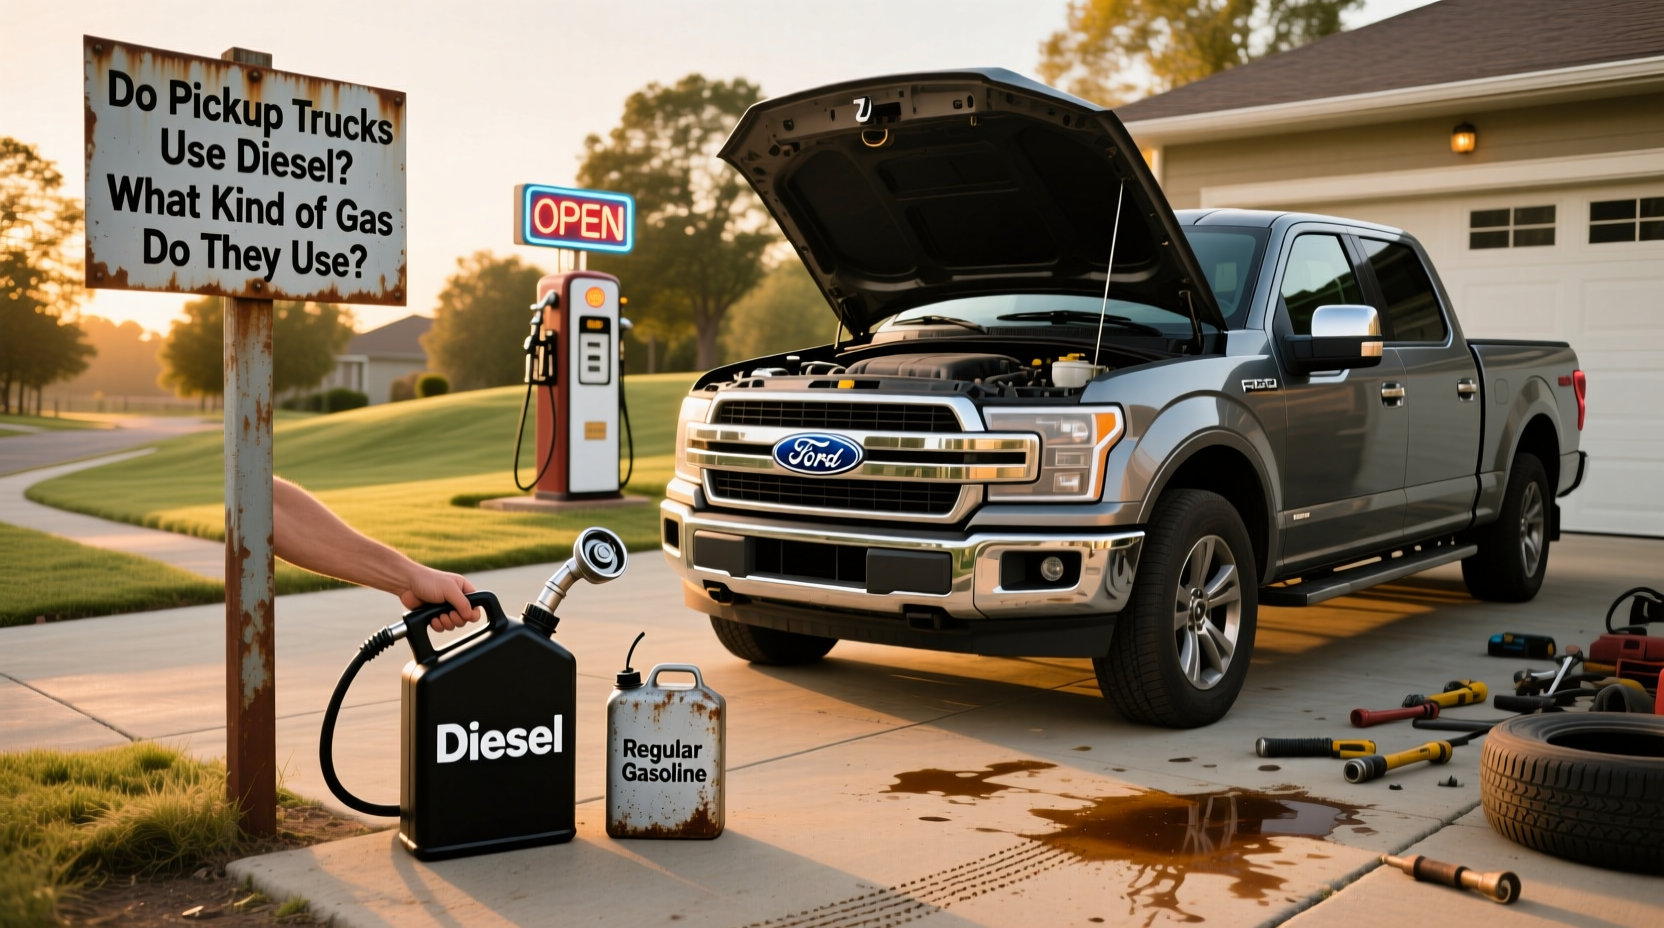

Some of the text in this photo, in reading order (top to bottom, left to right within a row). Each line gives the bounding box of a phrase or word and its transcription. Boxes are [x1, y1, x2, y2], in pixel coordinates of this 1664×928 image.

[108, 69, 393, 145] Do Pickup Trucks
[161, 127, 353, 185] Use Diesel?
[107, 173, 393, 236] What Kind of Gas
[534, 198, 624, 241] OPEN
[143, 228, 367, 283] Do They Use?
[789, 438, 844, 468] Ford
[436, 714, 563, 764] Diesel
[623, 739, 703, 764] Regular
[622, 761, 707, 783] Gasoline
